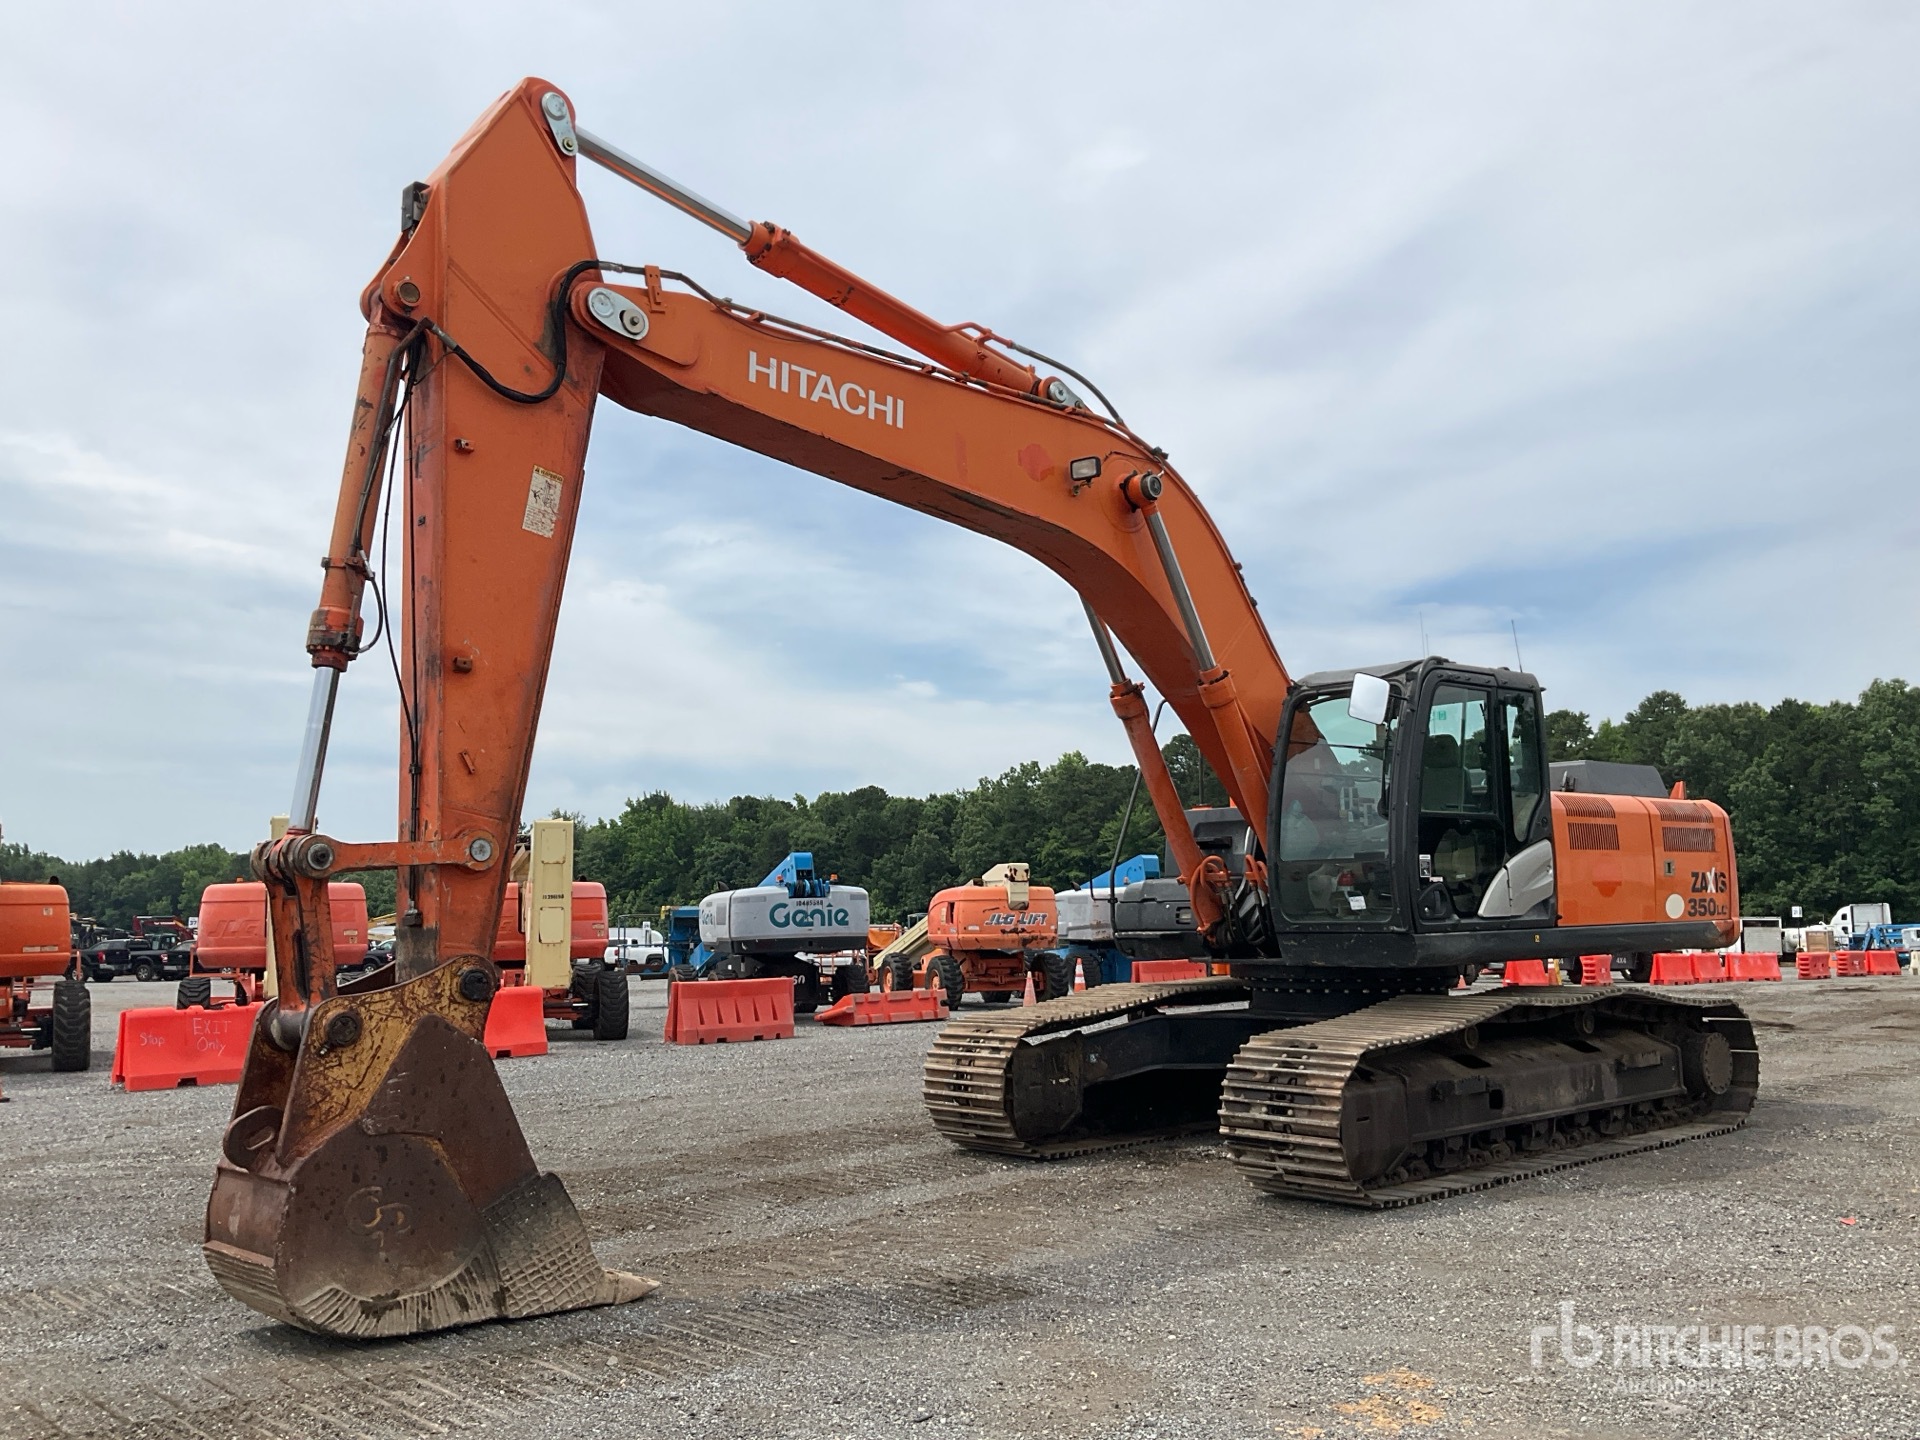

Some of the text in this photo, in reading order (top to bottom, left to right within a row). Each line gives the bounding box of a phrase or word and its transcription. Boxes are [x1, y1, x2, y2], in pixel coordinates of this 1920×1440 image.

[748, 350, 904, 430] HITACHI
[1690, 867, 1727, 893] ZAXIS
[769, 902, 849, 929] Genie
[984, 911, 1048, 926] JLG LIFT
[193, 1017, 232, 1035] EXIT
[139, 1032, 165, 1047] Stop
[196, 1036, 227, 1057] Only
